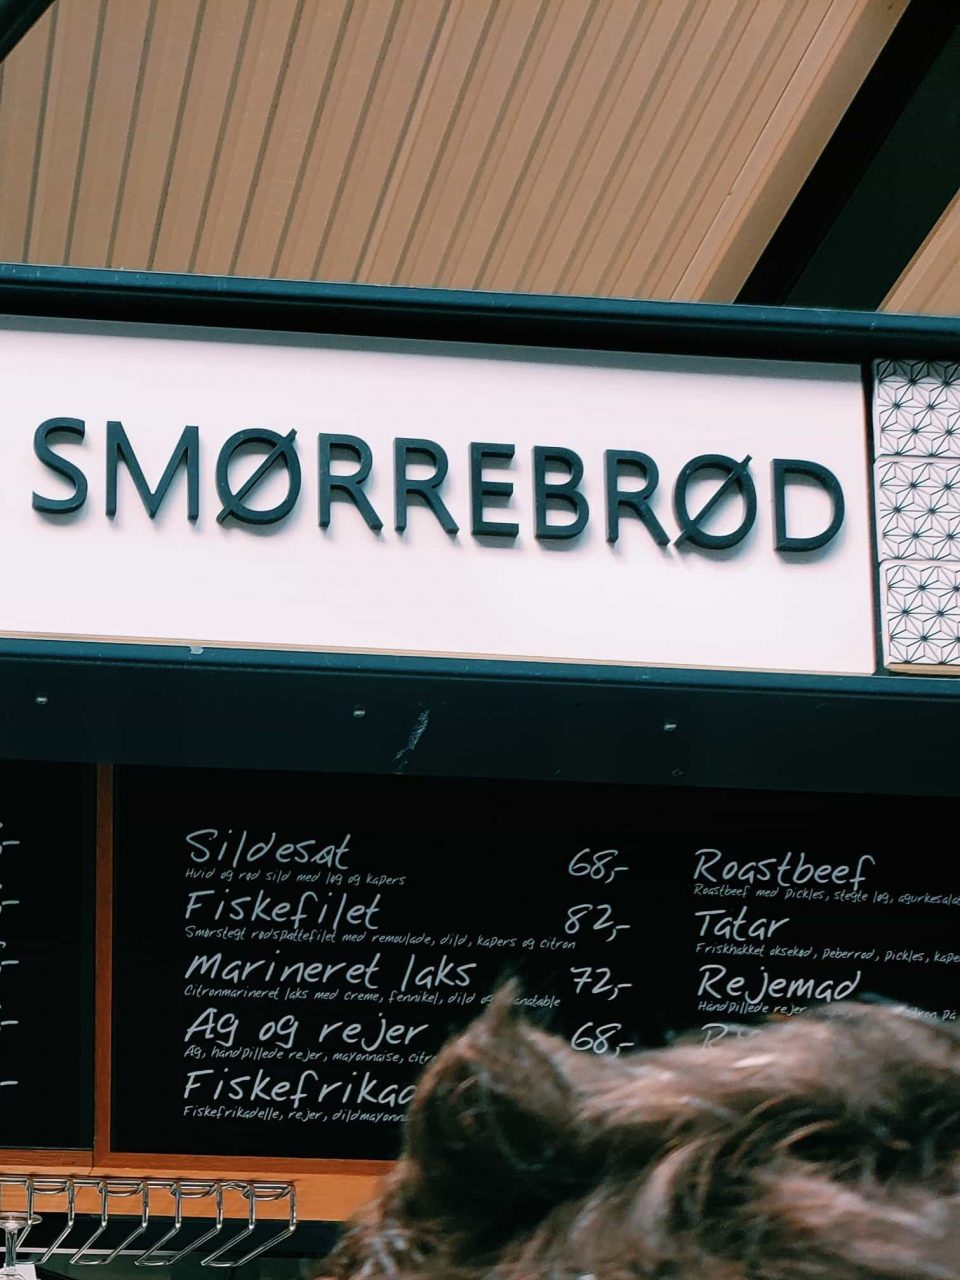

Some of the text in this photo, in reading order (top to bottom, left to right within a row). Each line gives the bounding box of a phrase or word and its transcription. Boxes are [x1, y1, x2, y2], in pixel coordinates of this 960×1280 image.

[32, 417, 844, 552] SMØRREBRØD
[185, 829, 629, 884] Sildesæt 68,-
[693, 848, 876, 891] Roastbeef
[185, 867, 216, 880] Hvid
[265, 870, 291, 883] sild
[296, 871, 321, 883] med
[366, 873, 407, 888] kapers
[693, 883, 751, 898] Roastbeef
[756, 887, 779, 898] med
[834, 889, 869, 902] stegte
[185, 889, 631, 942] Fiskefilet 82,-
[695, 906, 790, 941] Tatar
[184, 925, 246, 941] Smørstegt
[342, 932, 366, 943] med
[371, 932, 436, 947] remoulade,
[440, 933, 473, 948] dild,
[477, 934, 517, 949] kapers
[540, 936, 576, 950] citron
[696, 943, 765, 957] Friskhakket
[822, 949, 880, 962] peberrod,
[185, 950, 633, 1001] Marineret laks 72,-
[697, 964, 861, 1003] Rejemad
[184, 984, 280, 1000] Citronmarineret
[285, 987, 309, 1000] laks
[314, 988, 339, 1000] med
[344, 991, 384, 1004] creme,
[389, 989, 443, 1005] fennikel,
[448, 992, 476, 1004] dild
[258, 1014, 299, 1048] og
[318, 1012, 429, 1051] rejer
[571, 1021, 635, 1058] 68,-
[288, 1048, 329, 1062] rejer,
[332, 1050, 405, 1065] mayonnaise,
[184, 1105, 329, 1122] Fiskefrikadelle, rejer,
